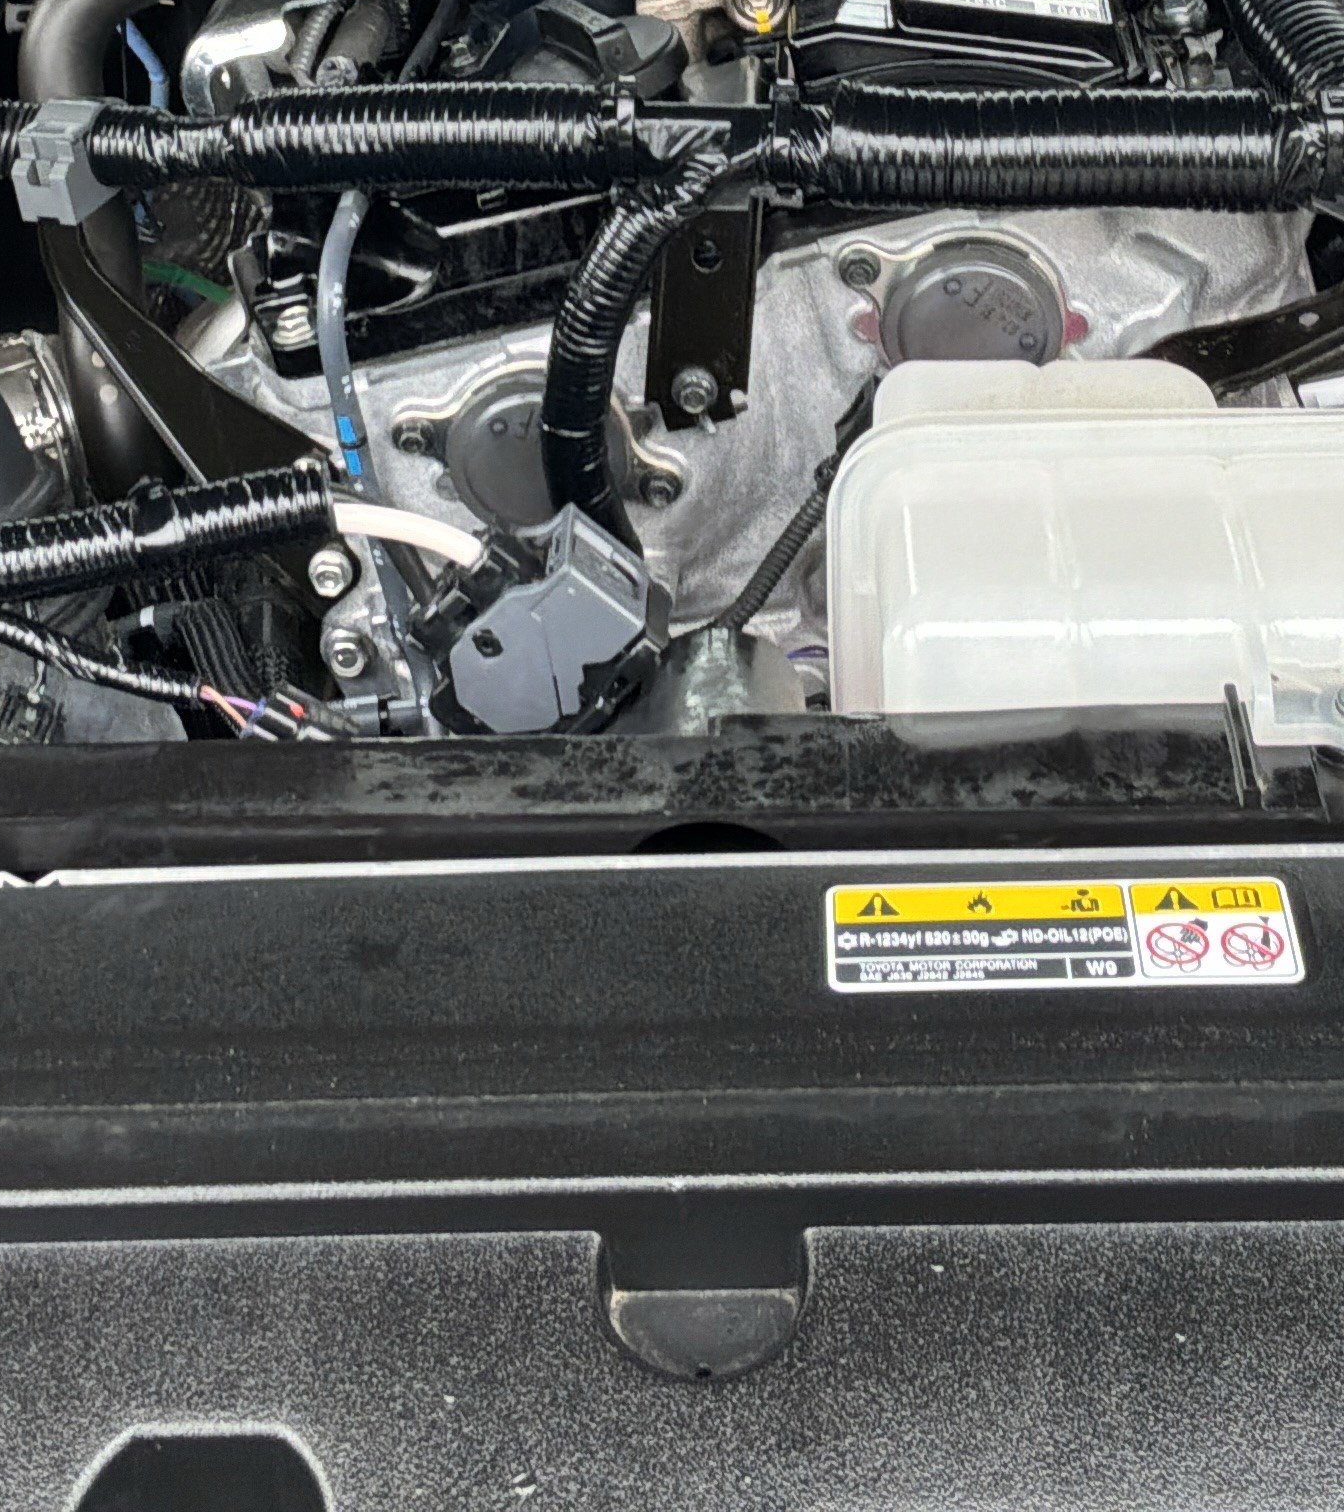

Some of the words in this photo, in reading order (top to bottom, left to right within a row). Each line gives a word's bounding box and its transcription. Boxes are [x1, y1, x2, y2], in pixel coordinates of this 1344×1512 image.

[860, 930, 922, 949] R-1234yf
[860, 961, 905, 973] TOYOTA
[909, 960, 951, 972] MOTOR
[955, 958, 1038, 971] CORPORATION
